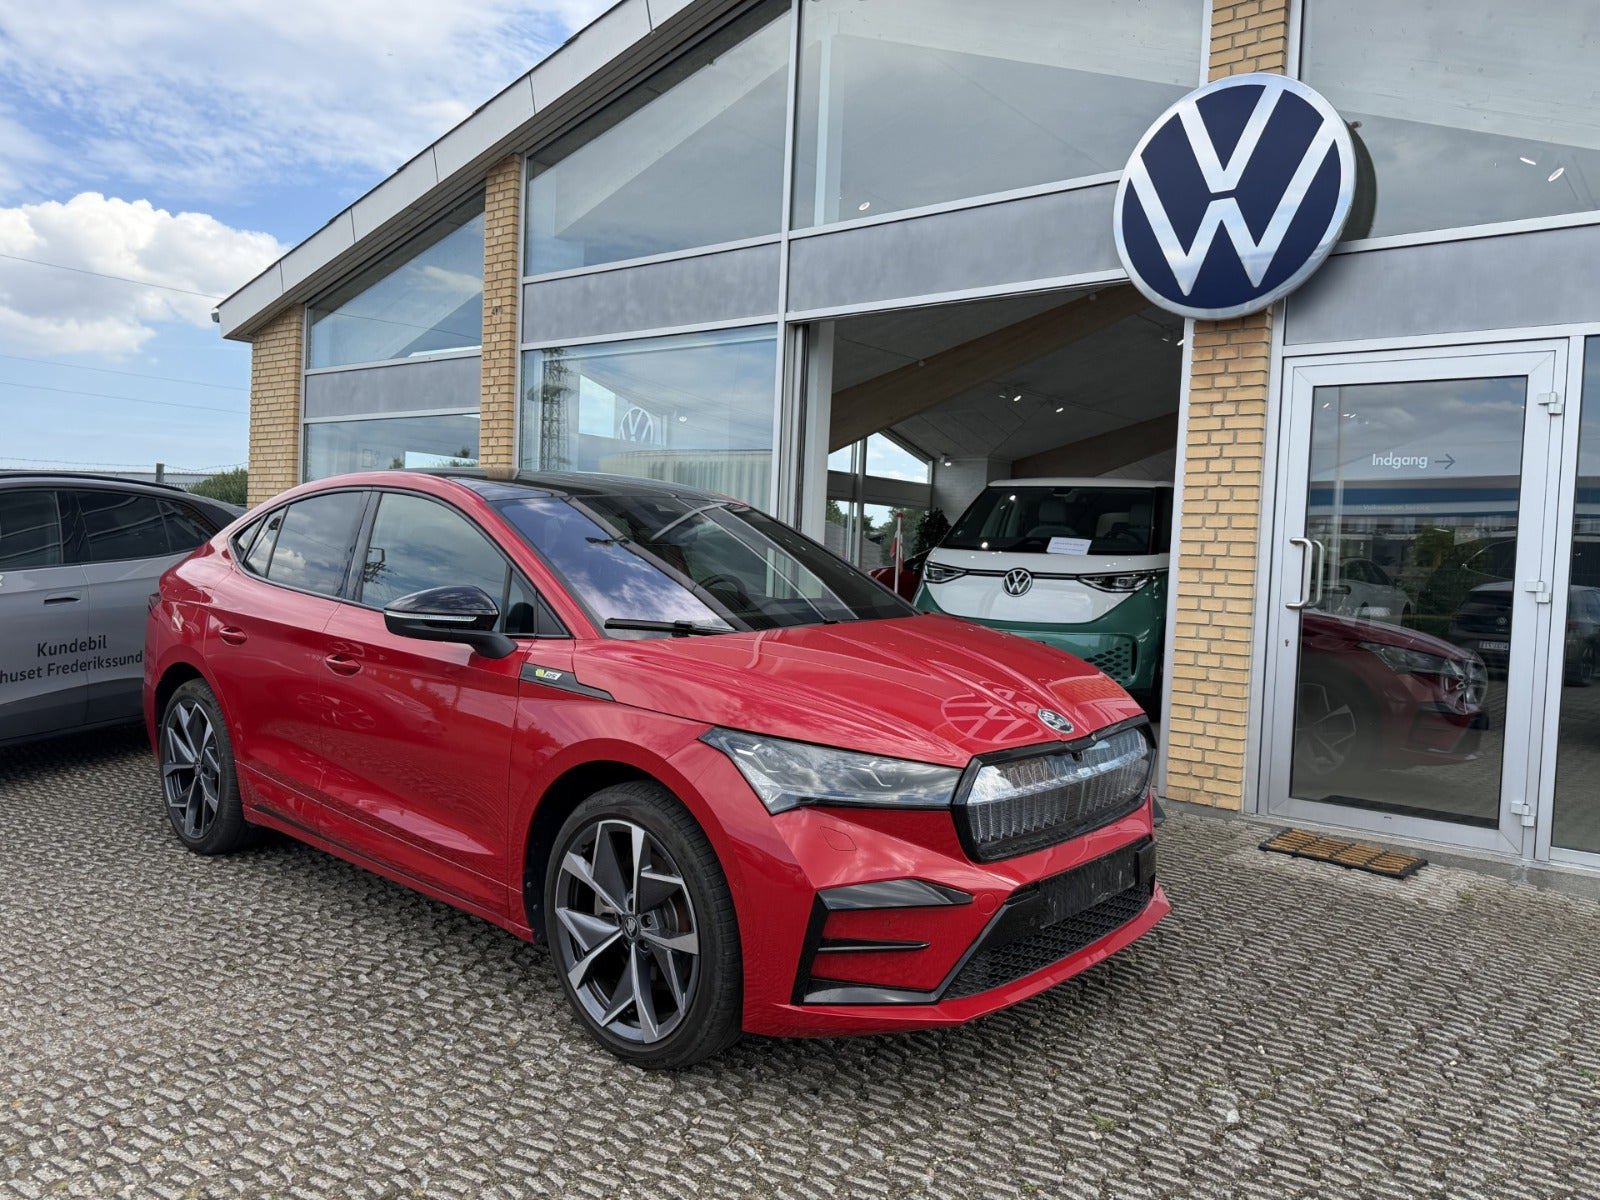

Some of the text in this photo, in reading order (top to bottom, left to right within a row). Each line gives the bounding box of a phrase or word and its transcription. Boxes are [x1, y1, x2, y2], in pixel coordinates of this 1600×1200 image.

[1118, 80, 1346, 302] VW
[1371, 453, 1428, 469] Indgang
[1004, 569, 1031, 595] VW
[37, 635, 107, 657] Kundebil
[0, 650, 143, 684] huset Frederikssund
